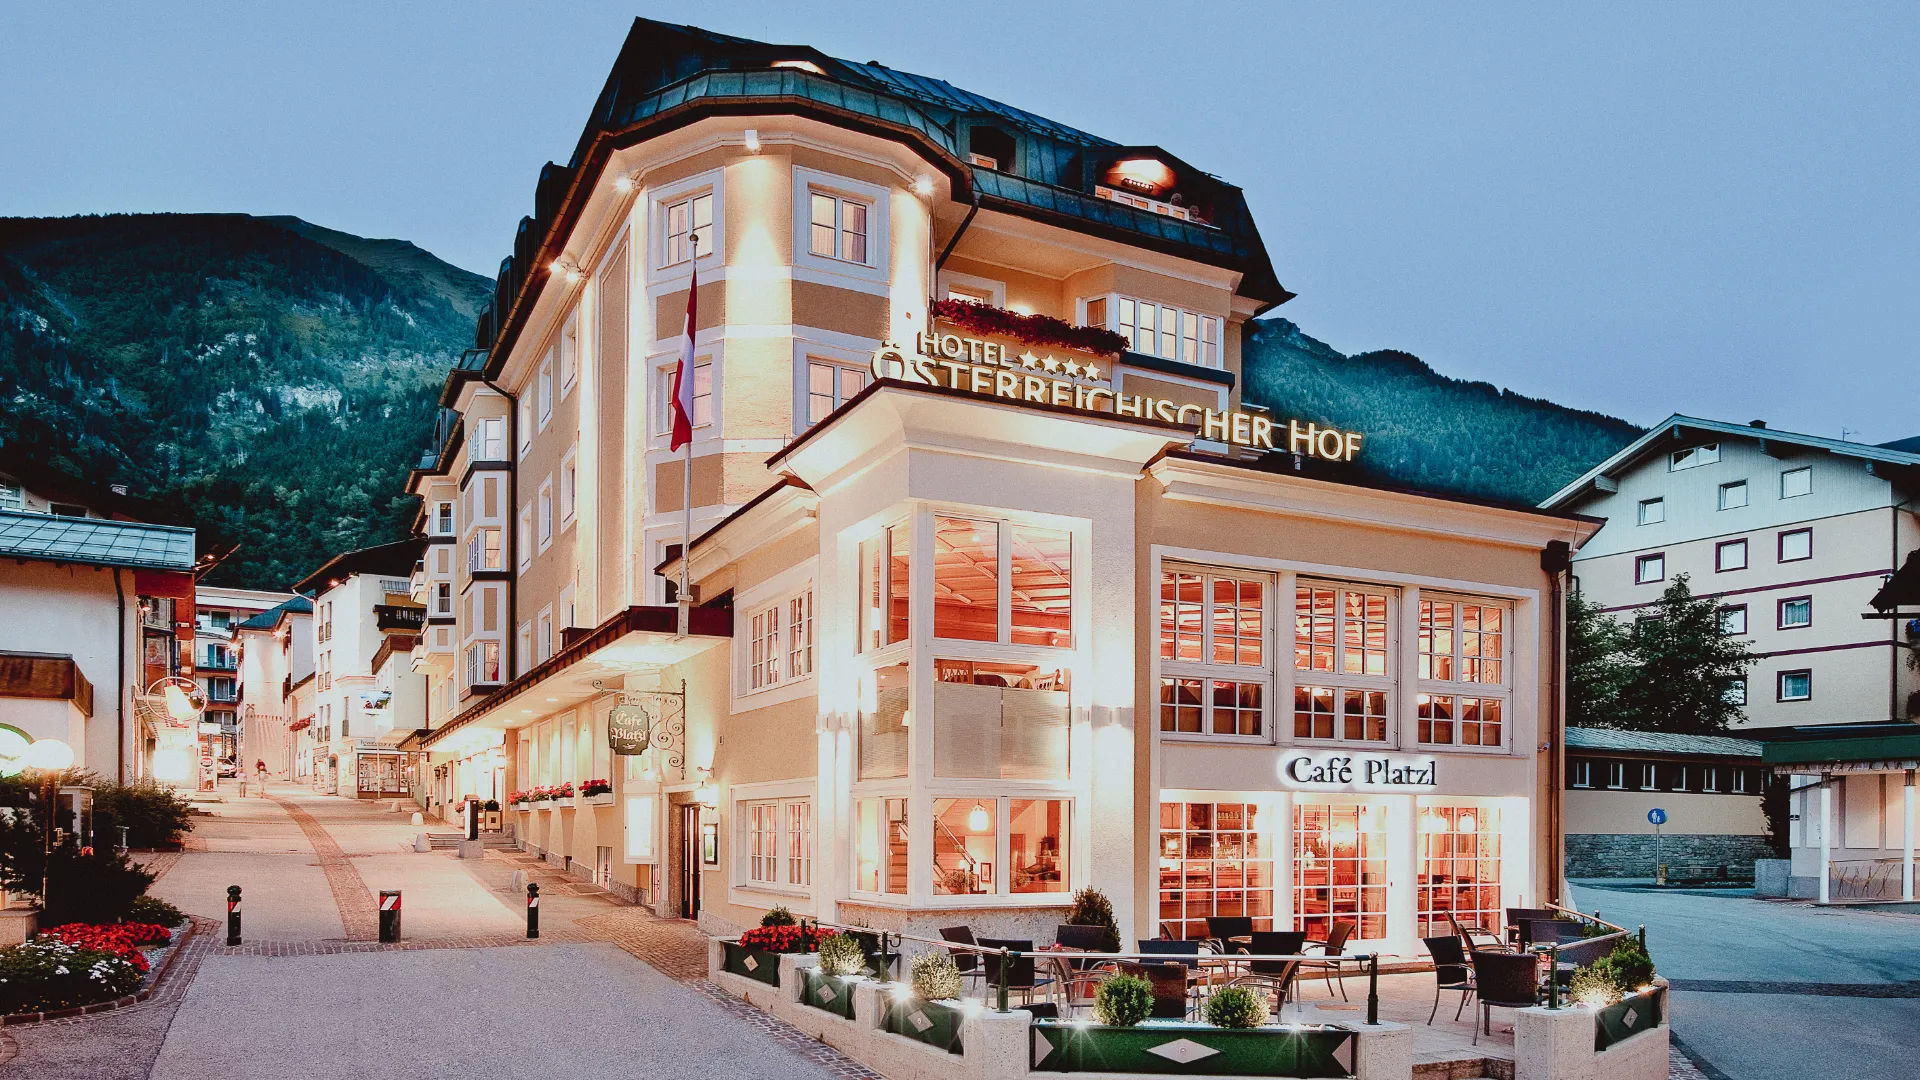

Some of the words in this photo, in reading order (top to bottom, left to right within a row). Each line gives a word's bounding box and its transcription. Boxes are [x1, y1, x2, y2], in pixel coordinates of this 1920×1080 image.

[917, 331, 1013, 368] HOTEL
[870, 340, 1273, 449] ÖSTERREICHISCHER
[1290, 419, 1362, 462] HOF
[611, 727, 648, 748] Platzl
[1285, 757, 1353, 784] Café
[1364, 758, 1438, 786] Platzl
